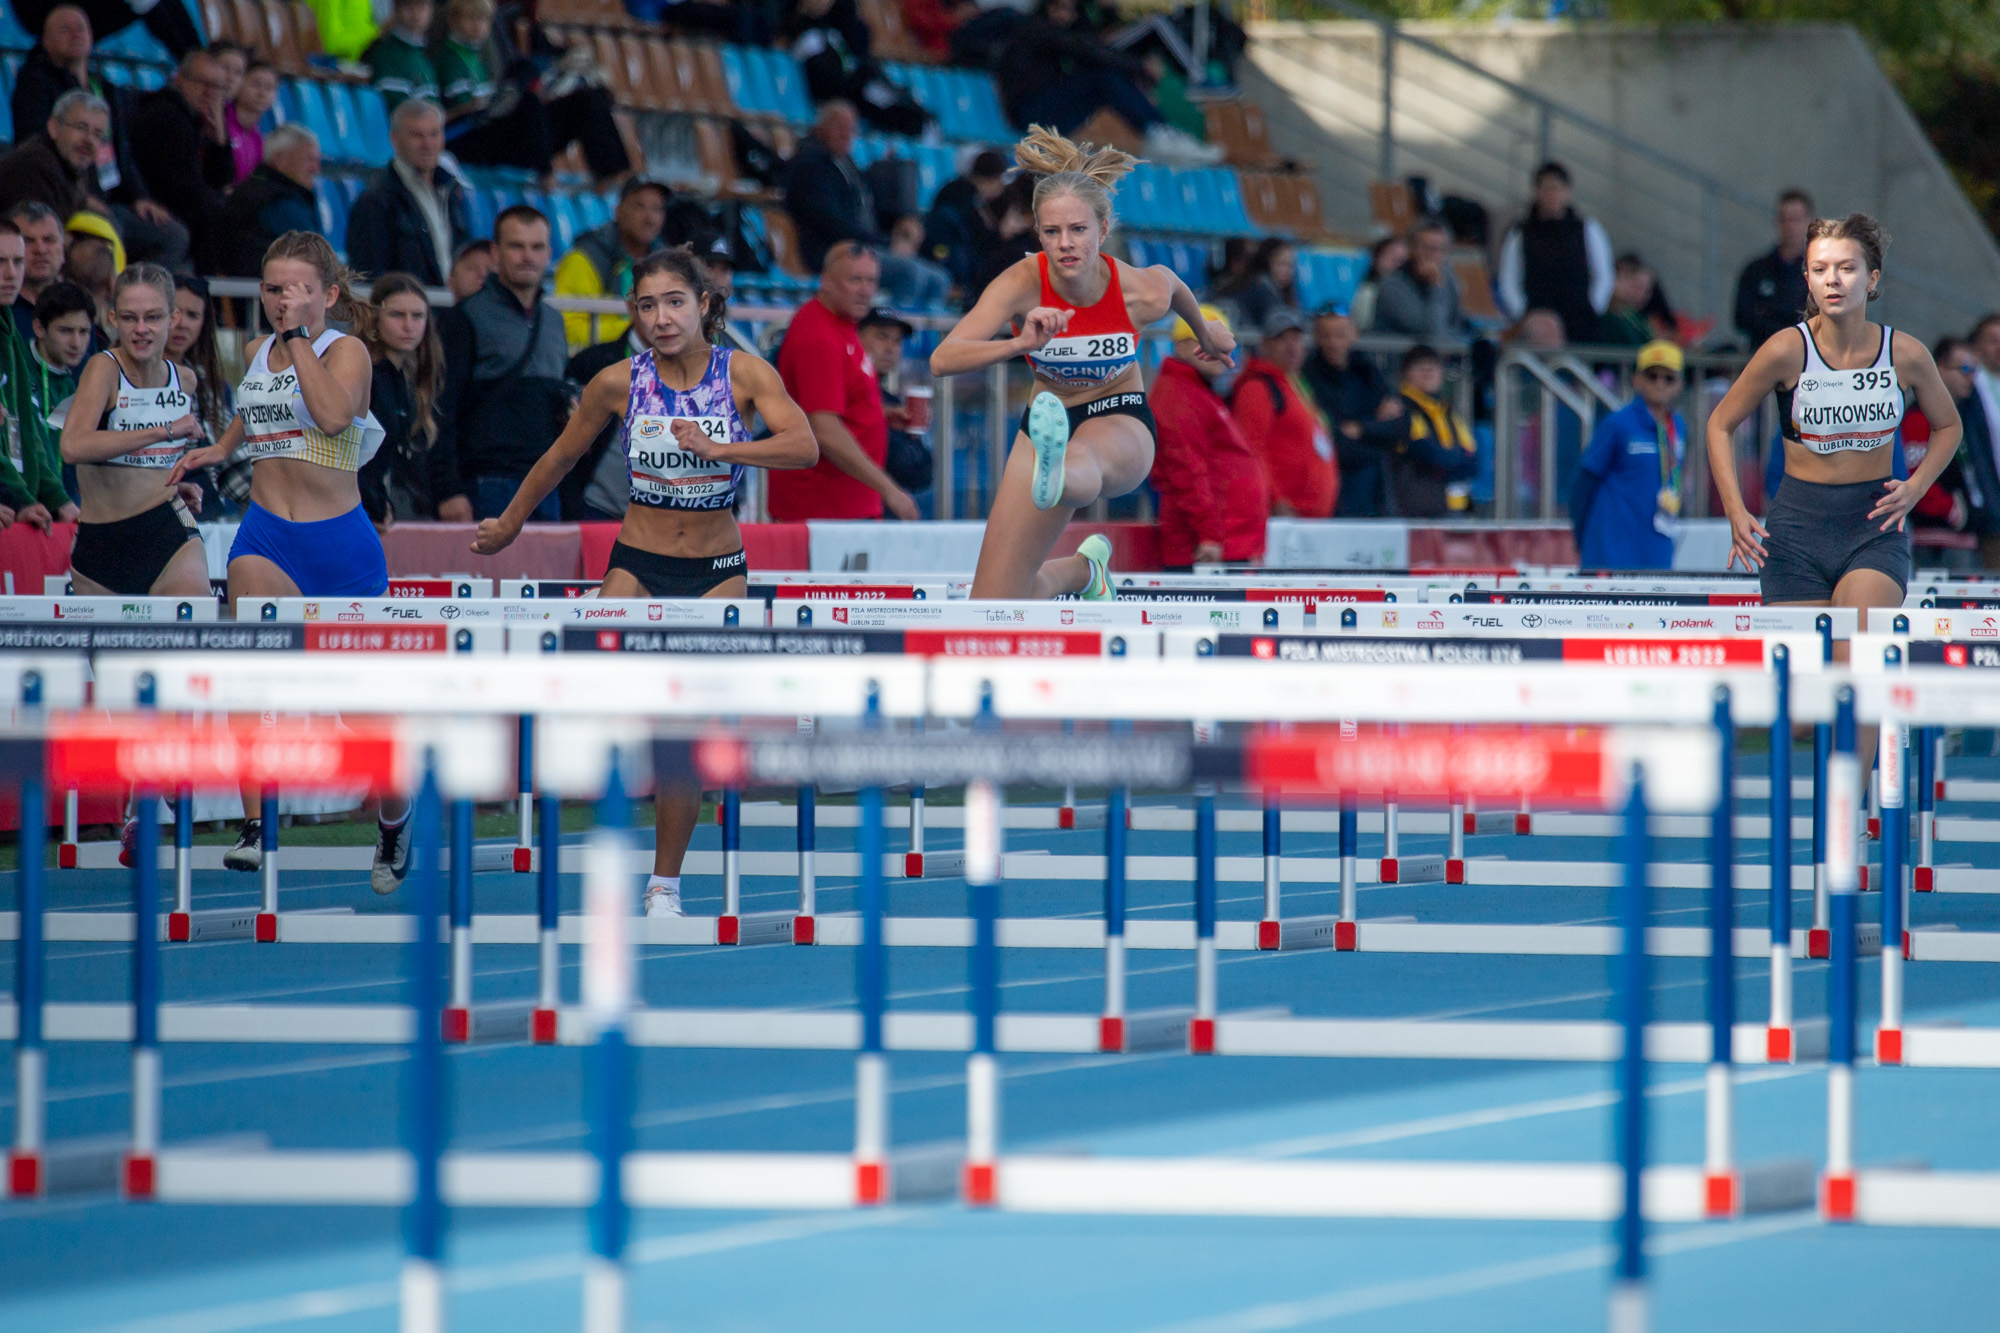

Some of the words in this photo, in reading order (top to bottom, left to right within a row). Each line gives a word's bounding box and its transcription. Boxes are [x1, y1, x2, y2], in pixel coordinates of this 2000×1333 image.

[1045, 347, 1078, 356] FUEL
[1087, 336, 1129, 357] 288
[244, 381, 264, 391] FUEL
[268, 375, 296, 394] 289
[1822, 380, 1844, 389] Okęcie
[1852, 370, 1892, 391] 395
[155, 390, 187, 409] 445
[1087, 396, 1119, 416] NIKE
[1121, 394, 1143, 406] PRO
[237, 403, 295, 425] RYSZEWSKA
[1803, 401, 1897, 425] KUTKOWSKA
[694, 420, 726, 438] 34
[272, 439, 292, 451] 2022
[1818, 439, 1853, 451] LUBLIN
[1857, 437, 1882, 448] 2022
[124, 455, 156, 464] LUBLIN
[649, 482, 684, 495] LUBLIN
[687, 484, 715, 495] 2022
[670, 495, 726, 508] NIKE
[712, 554, 740, 570] NIKE
[393, 587, 425, 598] 2022
[804, 591, 849, 600] LUBLIN
[855, 591, 886, 600] 2022
[62, 606, 95, 614] lubelskie
[392, 609, 423, 618] FUEL
[465, 609, 490, 617] Okęcie
[584, 608, 628, 619] polanik
[1150, 613, 1183, 621] lubelskie
[1472, 618, 1504, 627] FUEL
[1547, 618, 1573, 626] Okęcie
[1670, 618, 1714, 630] polanik
[92, 631, 197, 649] MISTRZOSTWA
[256, 630, 293, 650] 2021
[318, 632, 384, 650] LUBLIN
[391, 633, 435, 651] 2021
[1604, 645, 1672, 665] LUBLIN
[1677, 645, 1727, 666] 2022
